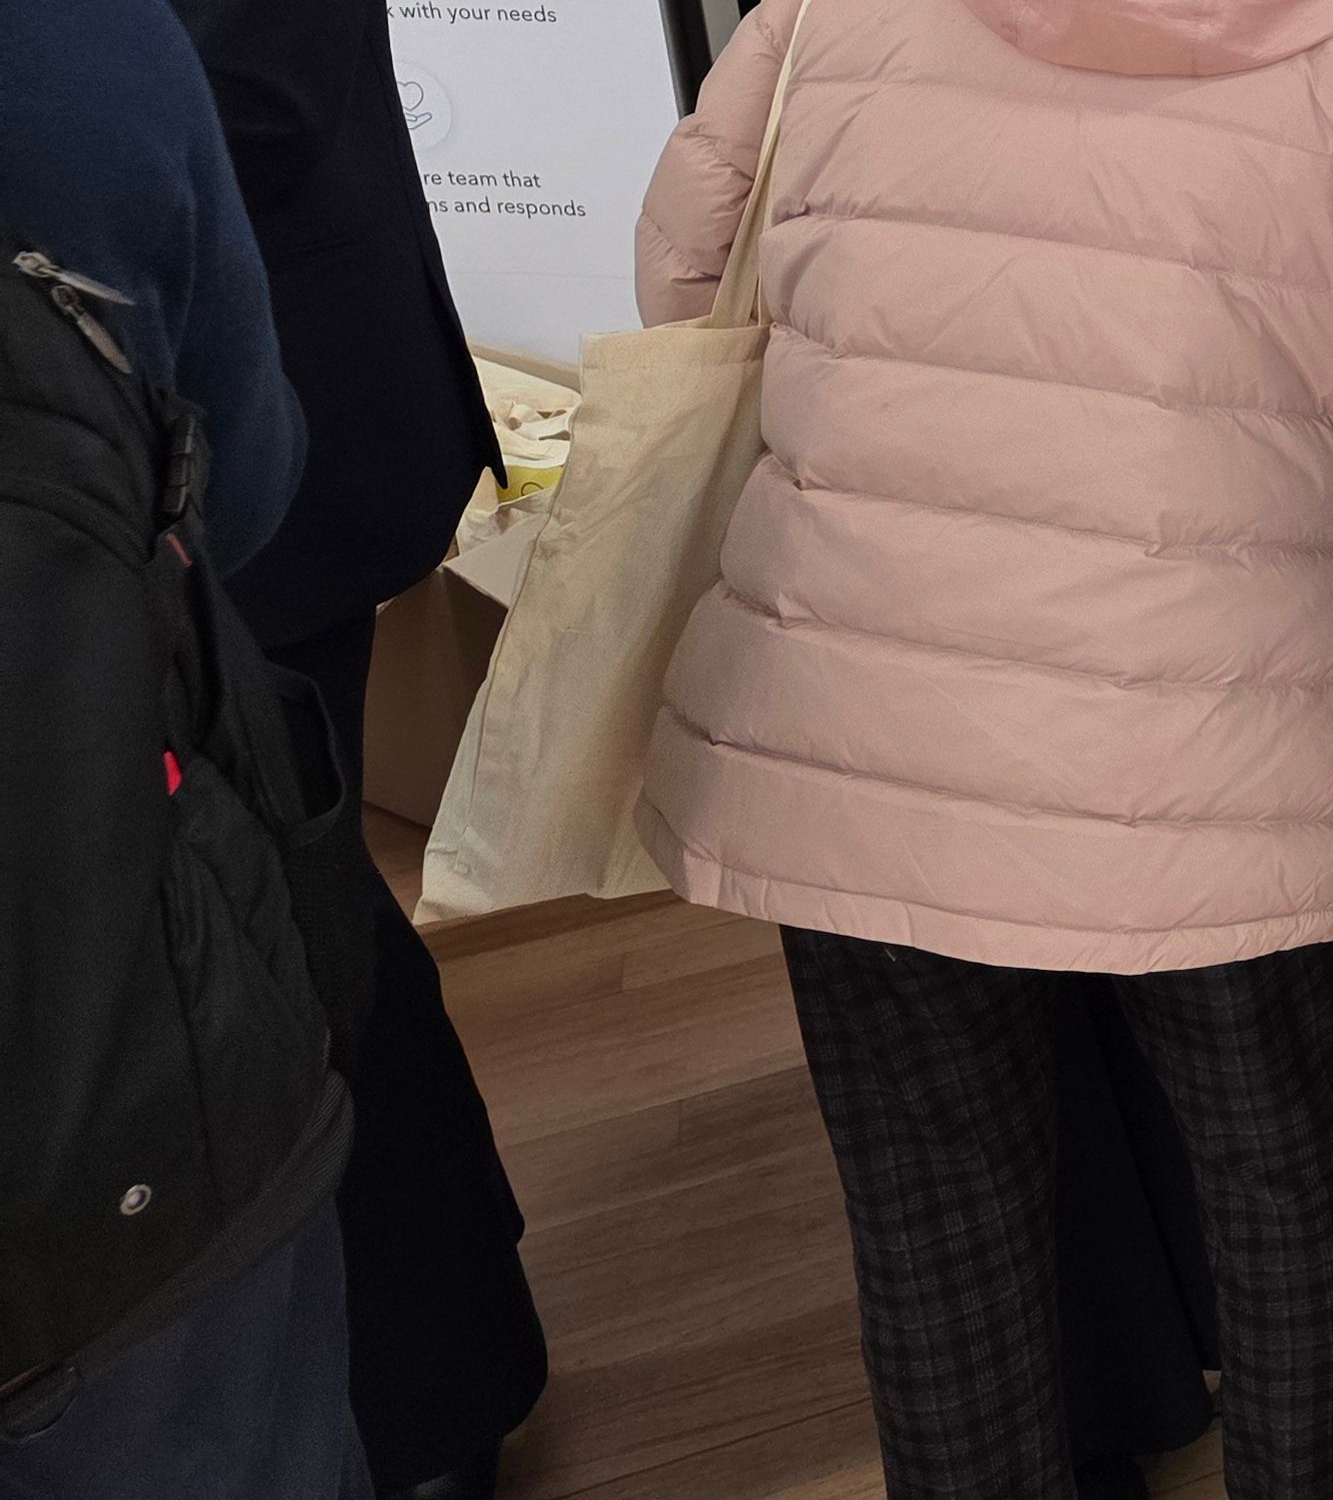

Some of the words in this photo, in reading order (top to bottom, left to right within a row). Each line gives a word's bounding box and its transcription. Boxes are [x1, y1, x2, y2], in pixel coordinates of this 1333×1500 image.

[399, 1, 442, 20] with
[447, 8, 491, 24] your
[496, 4, 557, 23] needs
[447, 171, 498, 187] team
[502, 169, 541, 189] that
[453, 195, 491, 214] and
[496, 199, 587, 219] responds
